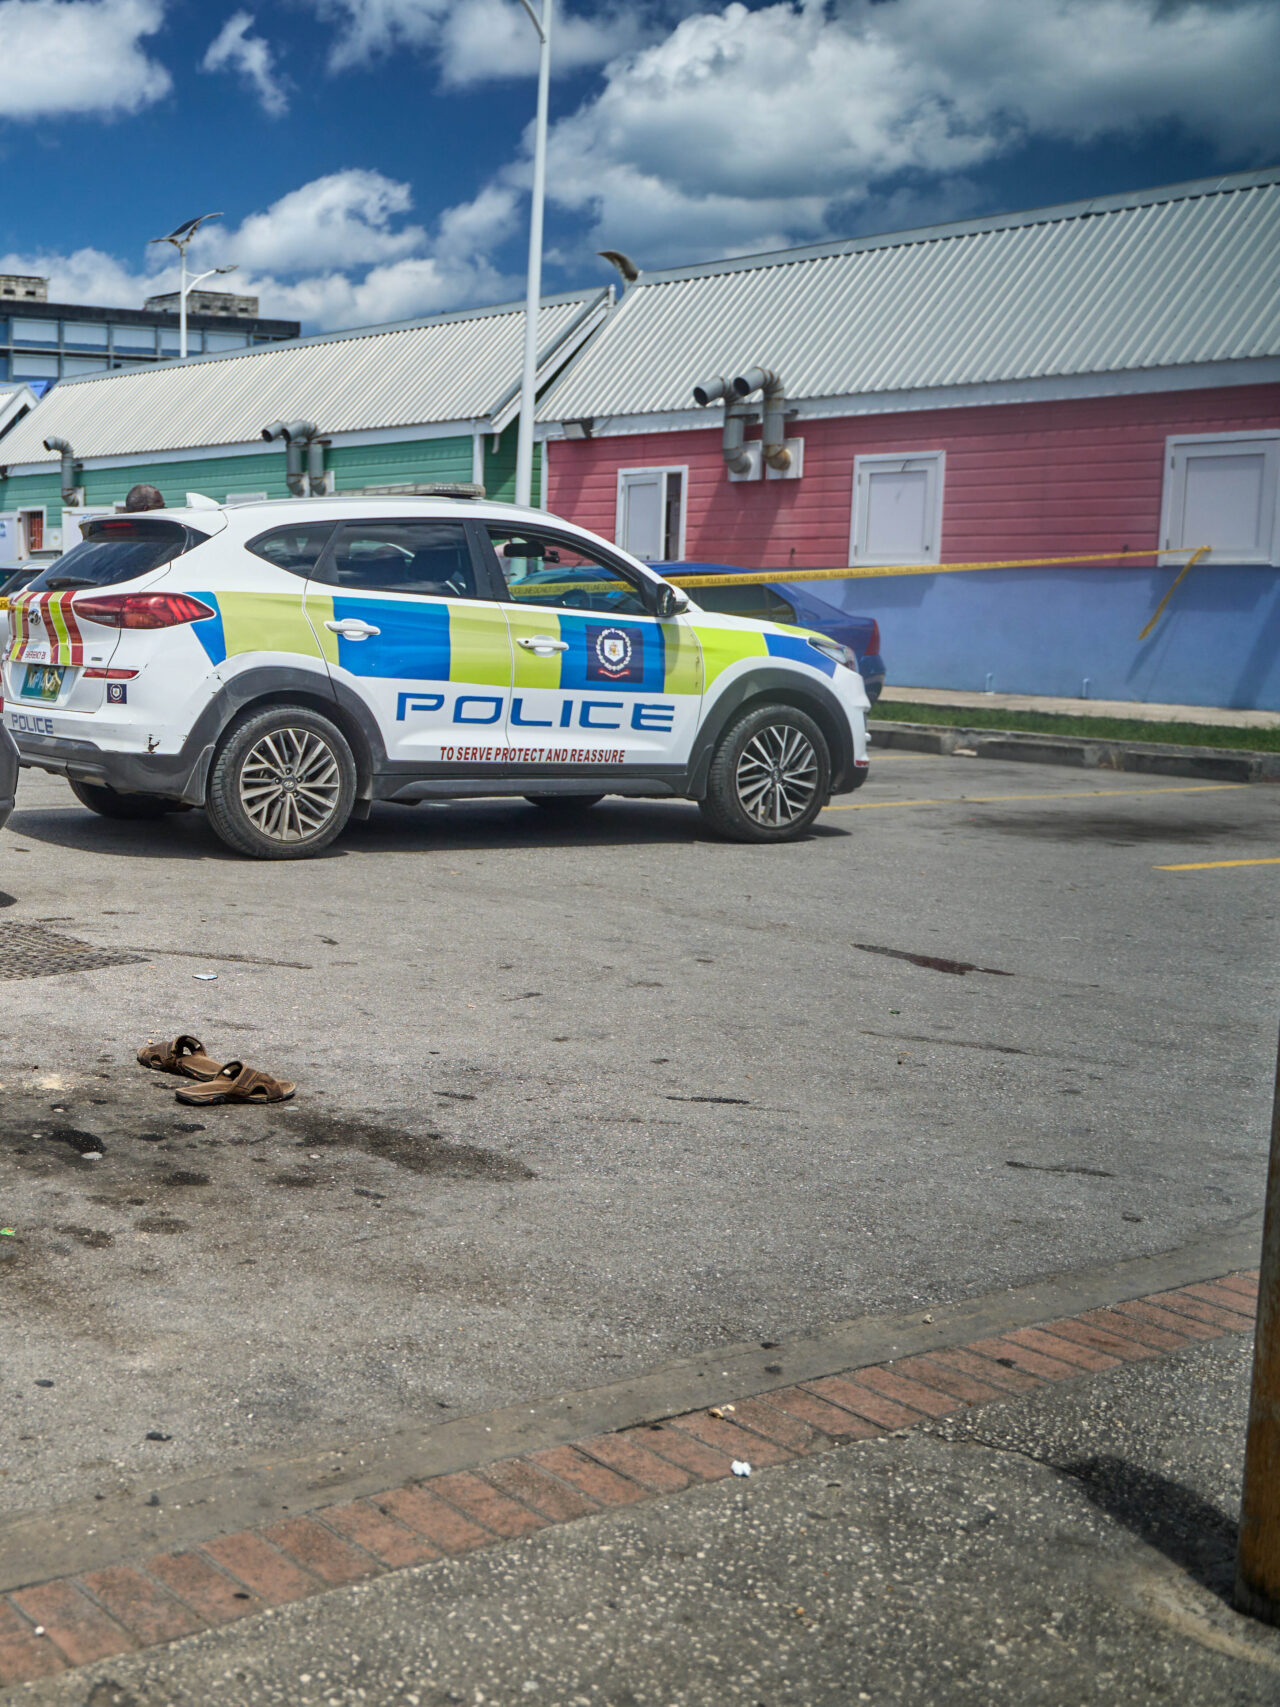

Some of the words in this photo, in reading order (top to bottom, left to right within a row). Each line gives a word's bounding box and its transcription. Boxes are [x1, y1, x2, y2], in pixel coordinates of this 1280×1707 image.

[395, 691, 676, 733] POLICE
[11, 713, 54, 735] POLICE
[440, 746, 454, 761] TO
[456, 746, 493, 761] SERVE
[494, 747, 545, 762] PROTECT
[545, 748, 568, 762] AND
[569, 749, 626, 763] REASSURE
